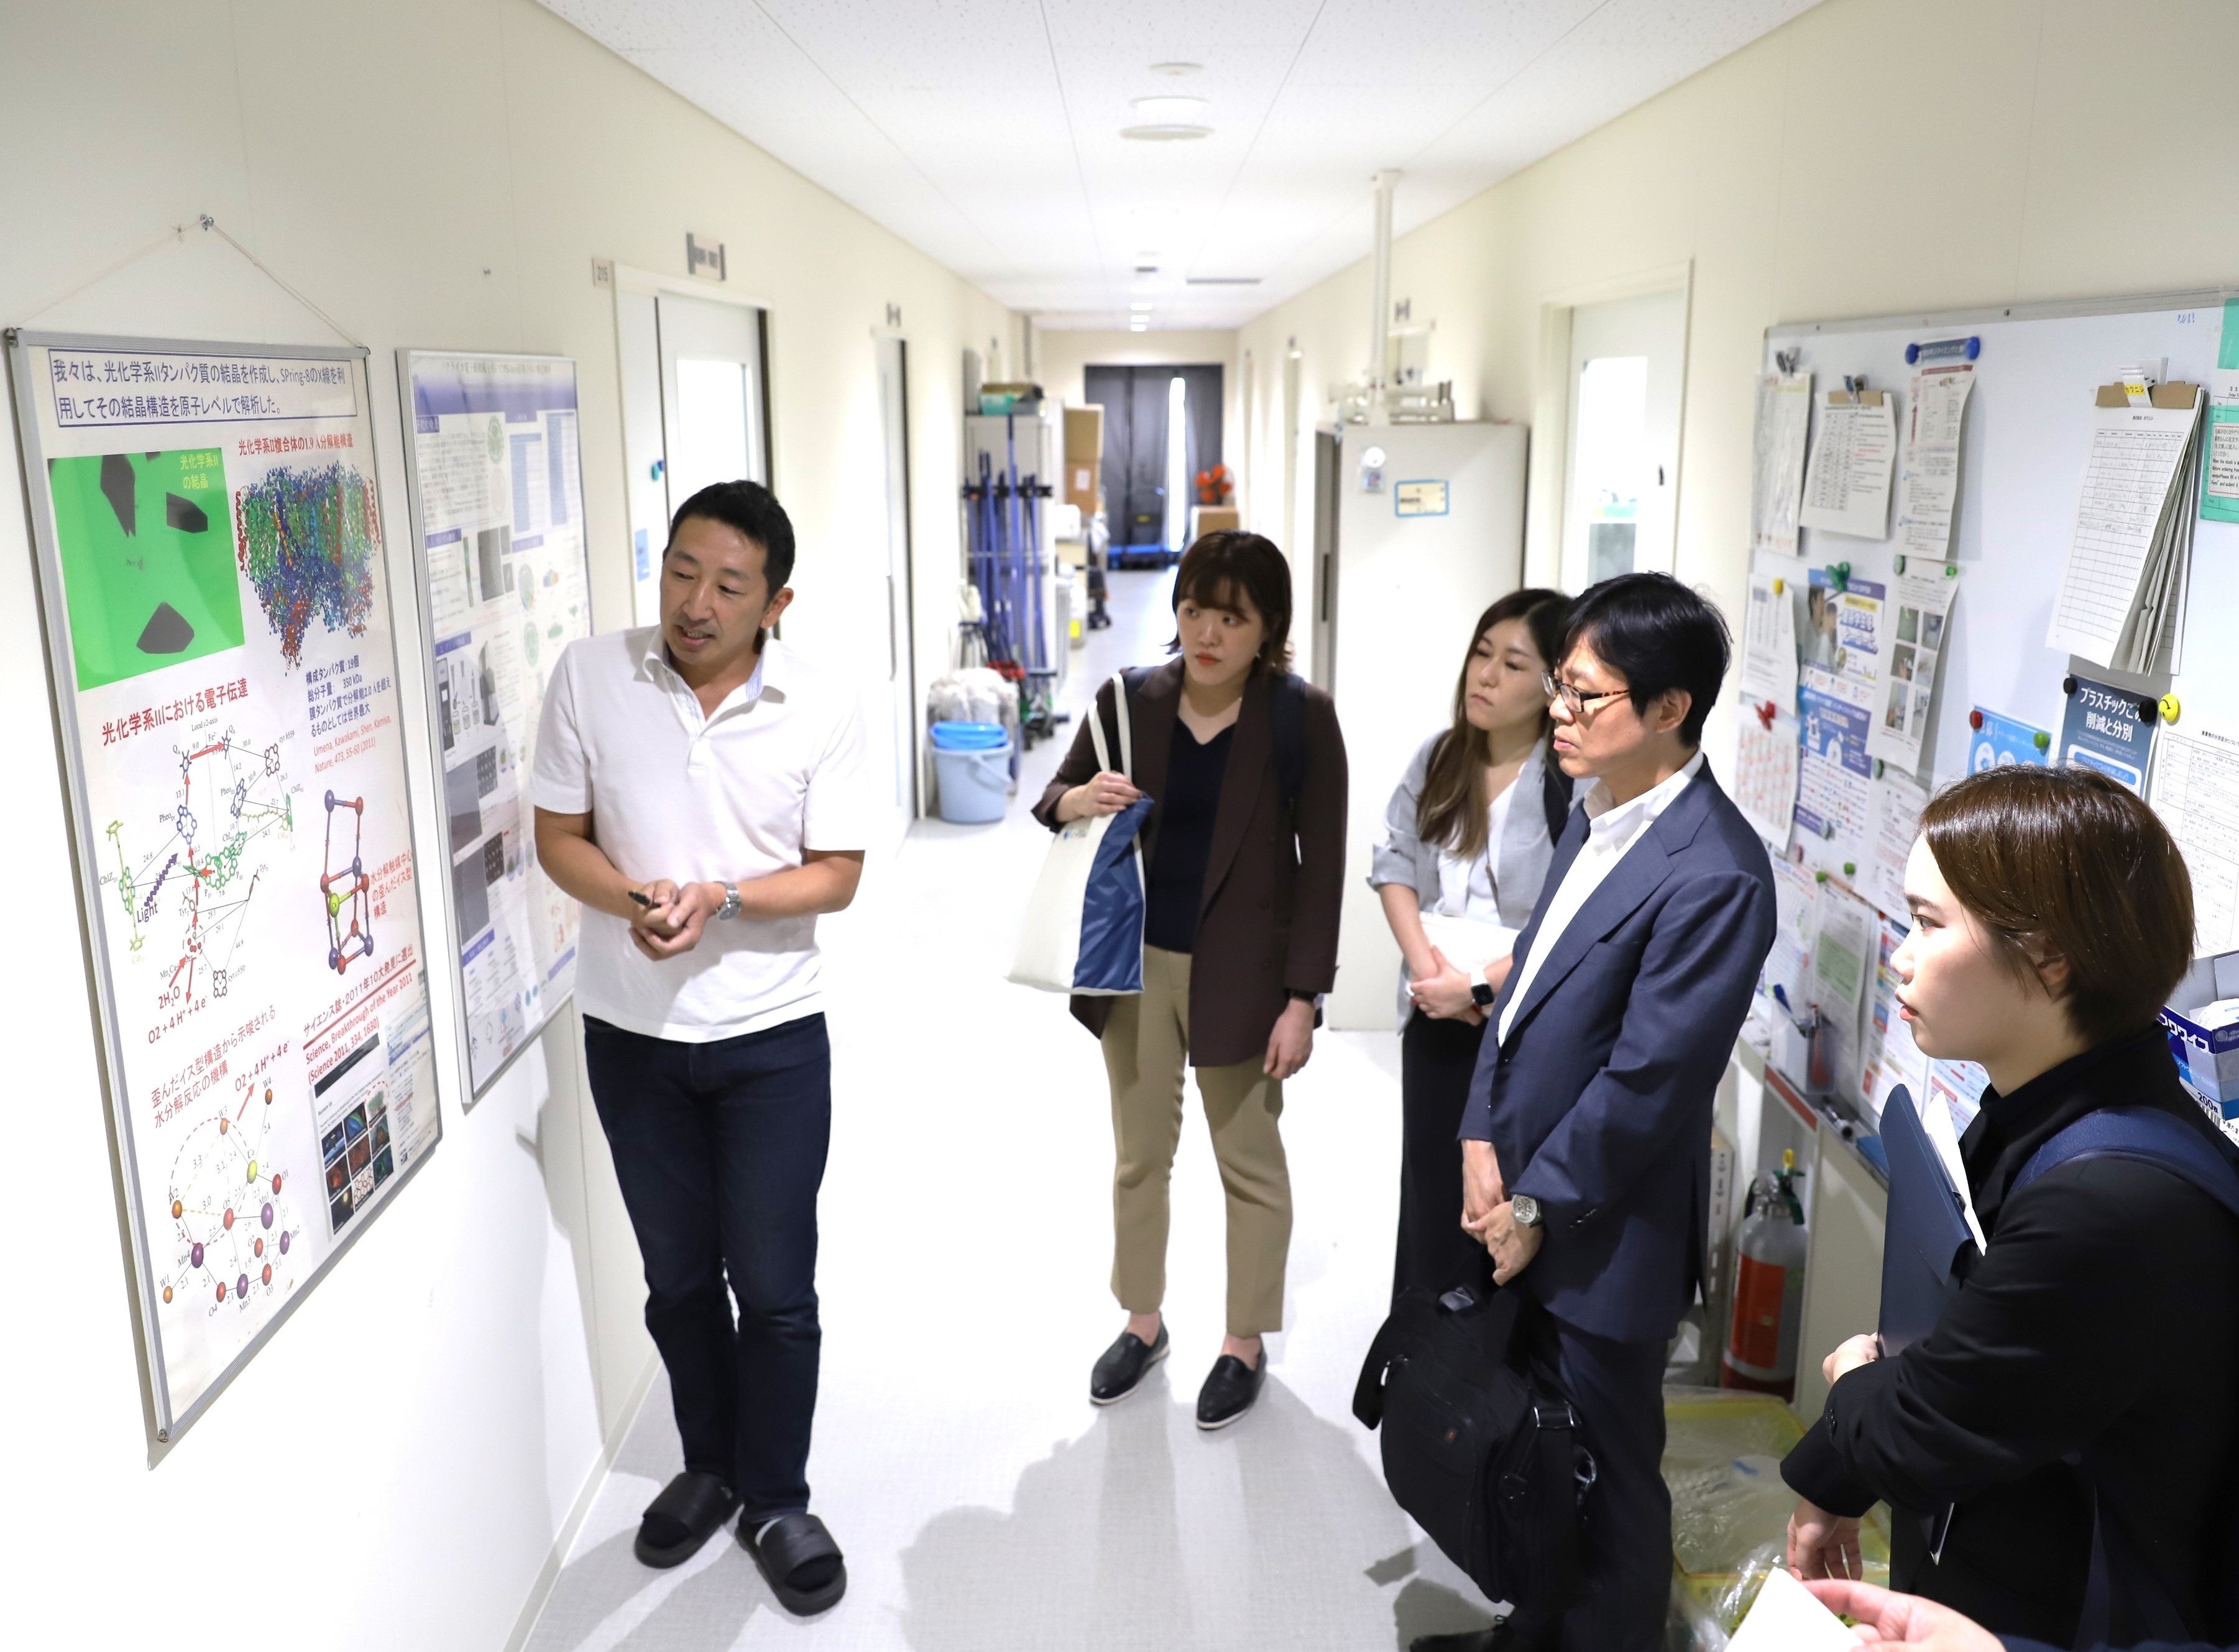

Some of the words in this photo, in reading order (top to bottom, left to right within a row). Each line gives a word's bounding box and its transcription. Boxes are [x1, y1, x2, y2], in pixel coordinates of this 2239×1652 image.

[60, 395, 280, 419] 用してその結晶構造を原子レベルで解析した。
[183, 474, 208, 490] の結晶
[343, 678, 352, 689] 350
[352, 674, 362, 686] kDa
[191, 722, 203, 732] Local
[311, 702, 370, 737] るものとしては世界最大
[2085, 711, 2133, 742] 削減と分別
[233, 763, 242, 771] 14.2
[176, 789, 185, 799] 13.1
[143, 852, 153, 863] 24.8
[195, 858, 204, 868] 10.4
[137, 902, 158, 923] Light
[374, 901, 387, 920] 構造
[216, 924, 224, 933] 29.1
[149, 1026, 160, 1044] O2
[170, 1016, 175, 1029] 4
[195, 1000, 199, 1012] 4
[306, 1040, 331, 1065] Science,
[331, 1006, 369, 1044] Breakthrough
[370, 998, 376, 1012] of
[377, 994, 385, 1007] the
[386, 984, 398, 996] Year
[399, 973, 412, 989] 2011
[151, 1004, 275, 1109] 歪んだイス型構造から示唆される
[308, 1057, 333, 1085] (Science
[351, 1032, 363, 1048] 334,
[236, 1074, 246, 1092] O2
[254, 1063, 259, 1076] 4
[277, 1045, 282, 1057] 4
[155, 1060, 228, 1129] 水分解反応の機構
[193, 1155, 202, 1169] 3.3
[202, 1196, 211, 1210] 3.0
[177, 1249, 190, 1269] Mn4
[180, 1277, 189, 1290] 2.1
[203, 1275, 211, 1288] 2.1
[209, 1303, 218, 1316] O4
[239, 1295, 251, 1313] Mn3
